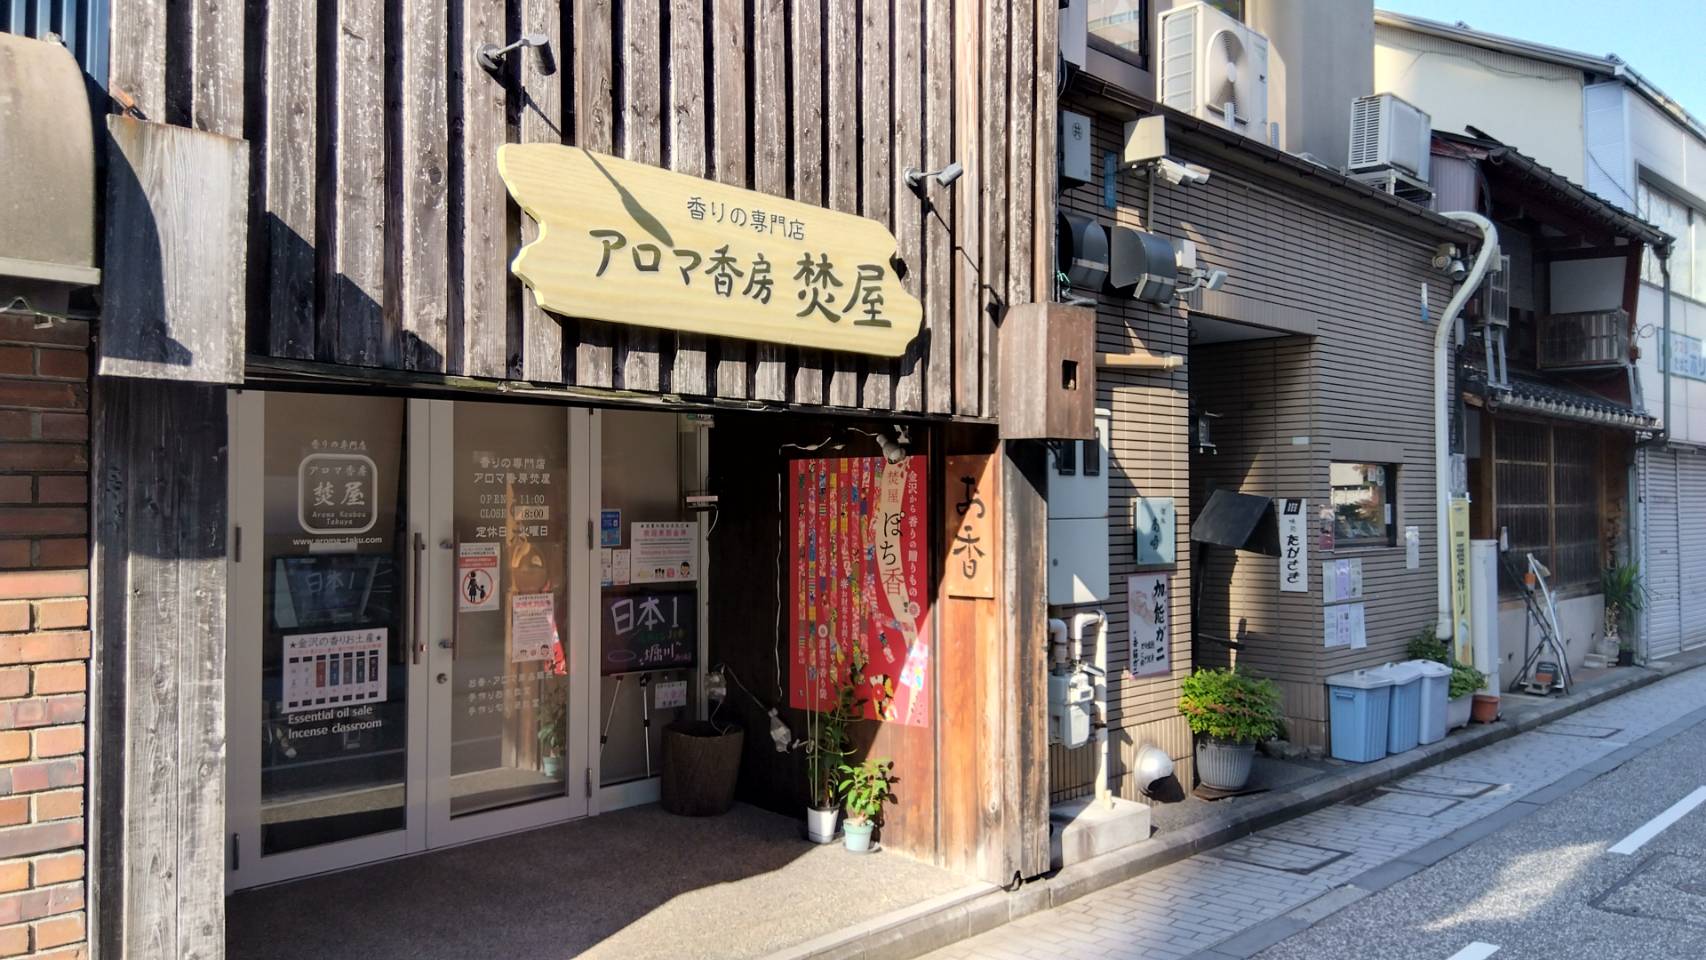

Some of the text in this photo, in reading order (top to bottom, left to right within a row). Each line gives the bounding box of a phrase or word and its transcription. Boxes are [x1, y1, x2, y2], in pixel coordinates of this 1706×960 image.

[687, 197, 805, 241] 香りの専門店
[589, 229, 892, 329] アロマ香房 焚屋
[313, 481, 366, 506] 焚屋
[520, 494, 545, 504] 11:00
[475, 526, 507, 538] 定休日
[952, 475, 986, 580] お香
[288, 706, 373, 725] Essential oil sale
[288, 719, 382, 739] Incense classroom
